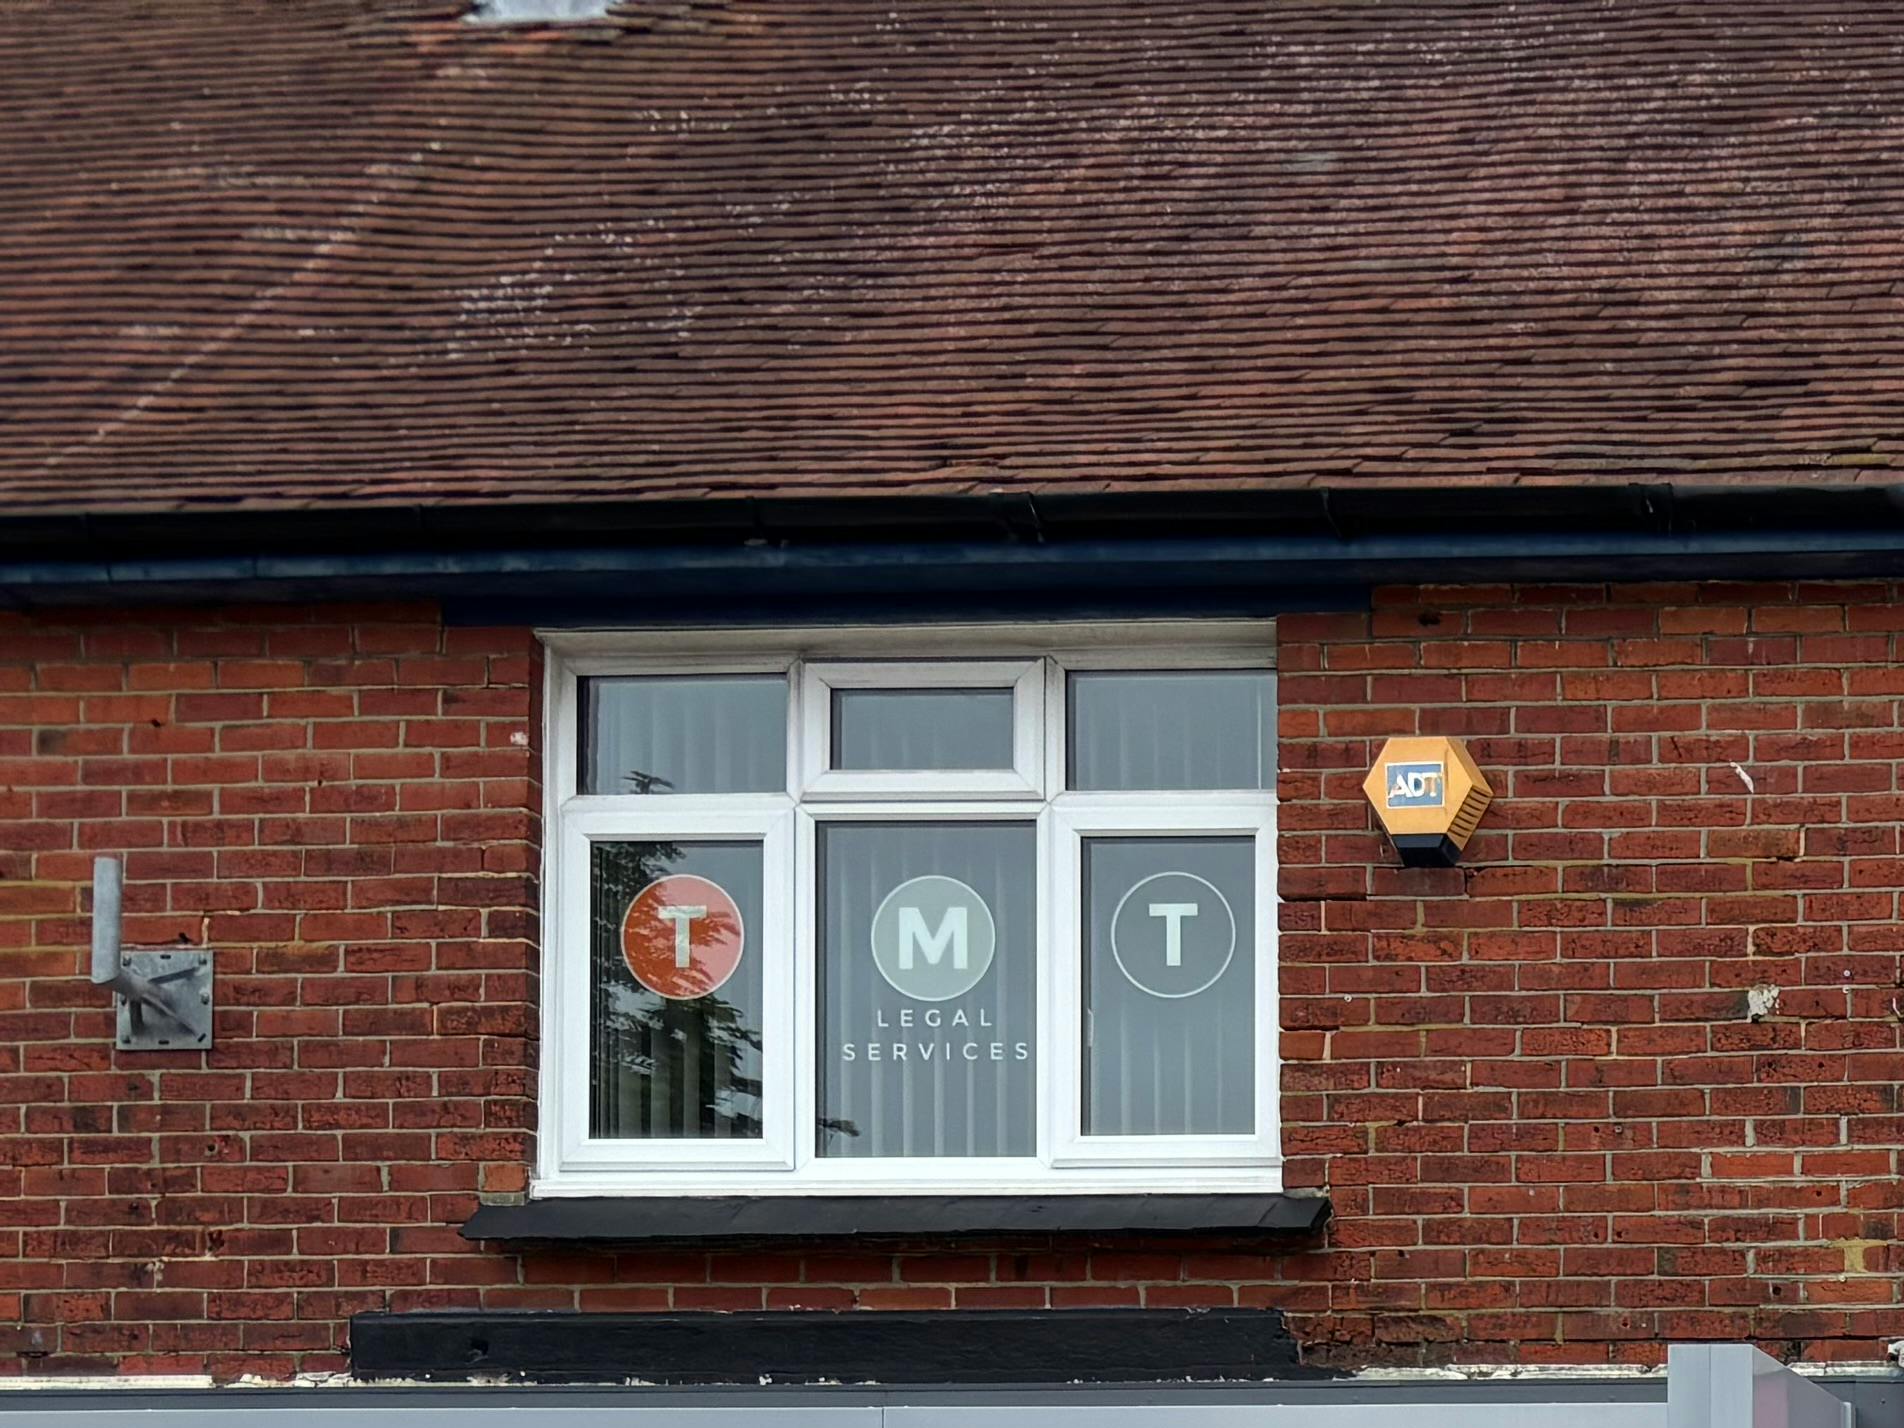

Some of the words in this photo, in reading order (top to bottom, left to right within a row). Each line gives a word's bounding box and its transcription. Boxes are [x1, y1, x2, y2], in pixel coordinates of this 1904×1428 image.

[1388, 772, 1440, 798] ADT
[878, 1008, 994, 1030] LEGAL
[842, 1042, 1033, 1063] SERVICES
